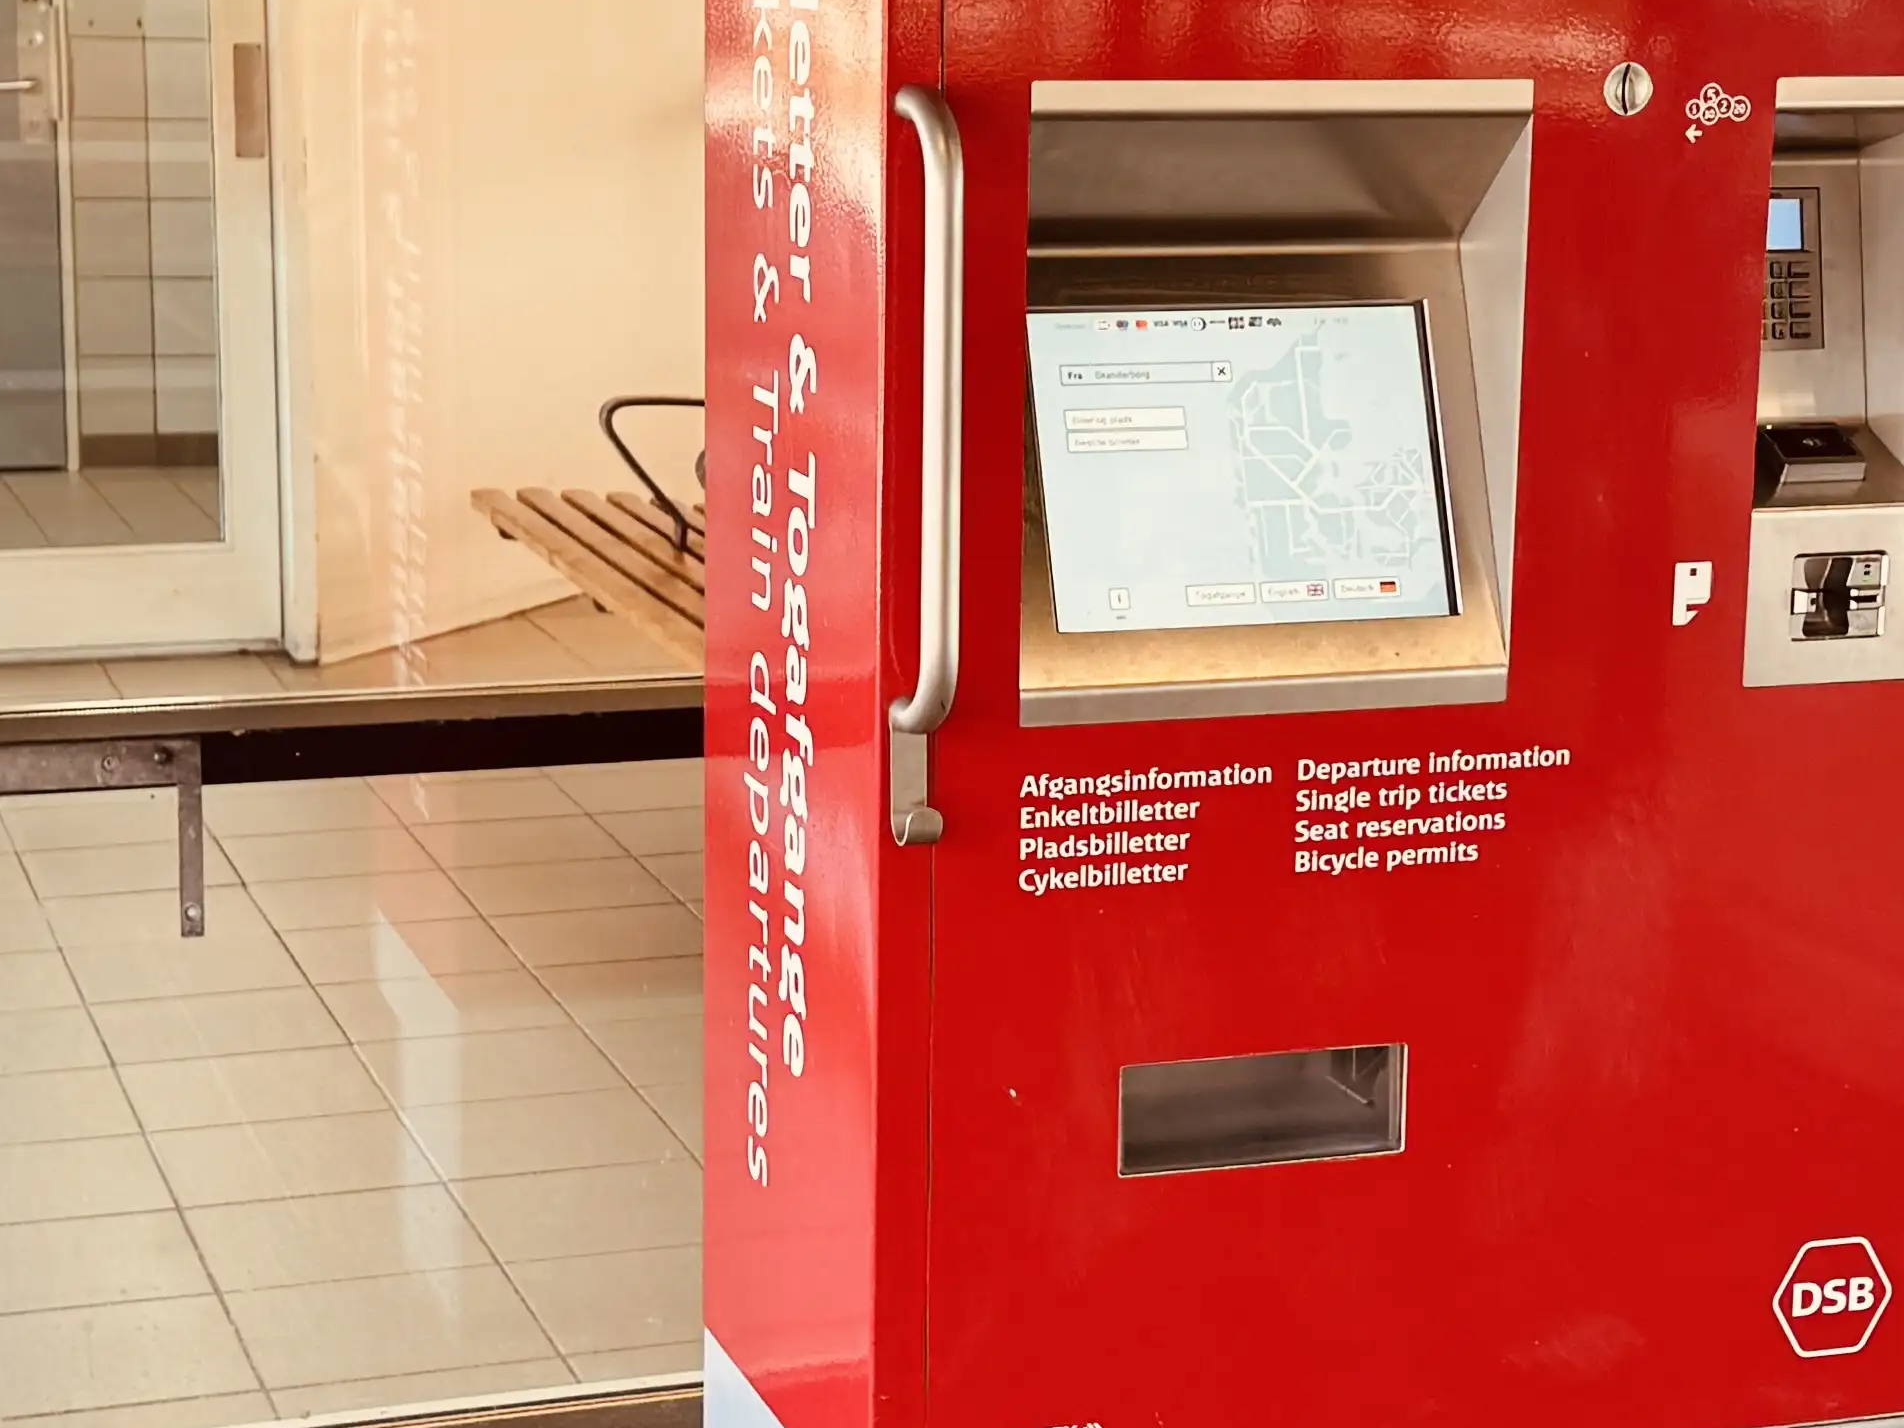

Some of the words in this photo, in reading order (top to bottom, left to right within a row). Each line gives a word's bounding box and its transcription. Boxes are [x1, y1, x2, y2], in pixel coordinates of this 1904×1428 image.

[752, 252, 780, 323] &
[789, 333, 817, 415] &
[751, 369, 780, 609] Train
[780, 451, 817, 1077] Togafgange
[1019, 763, 1272, 799] Afgangsinformation
[1297, 757, 1421, 783] Departure
[1428, 745, 1570, 774] information
[1020, 798, 1200, 830] Enkeltbilletter
[1295, 786, 1370, 813] Single
[1378, 785, 1420, 810] trip
[1429, 779, 1508, 804] tickets
[1019, 829, 1190, 861] Pladsbilletter
[1295, 820, 1348, 843] Seat
[1356, 810, 1505, 838] reservations
[1294, 846, 1379, 875] Bicycle
[1386, 841, 1479, 871] permits
[1018, 860, 1189, 895] Cykelbilletter
[746, 651, 780, 1188] departures
[1791, 1277, 1875, 1318] DSB
